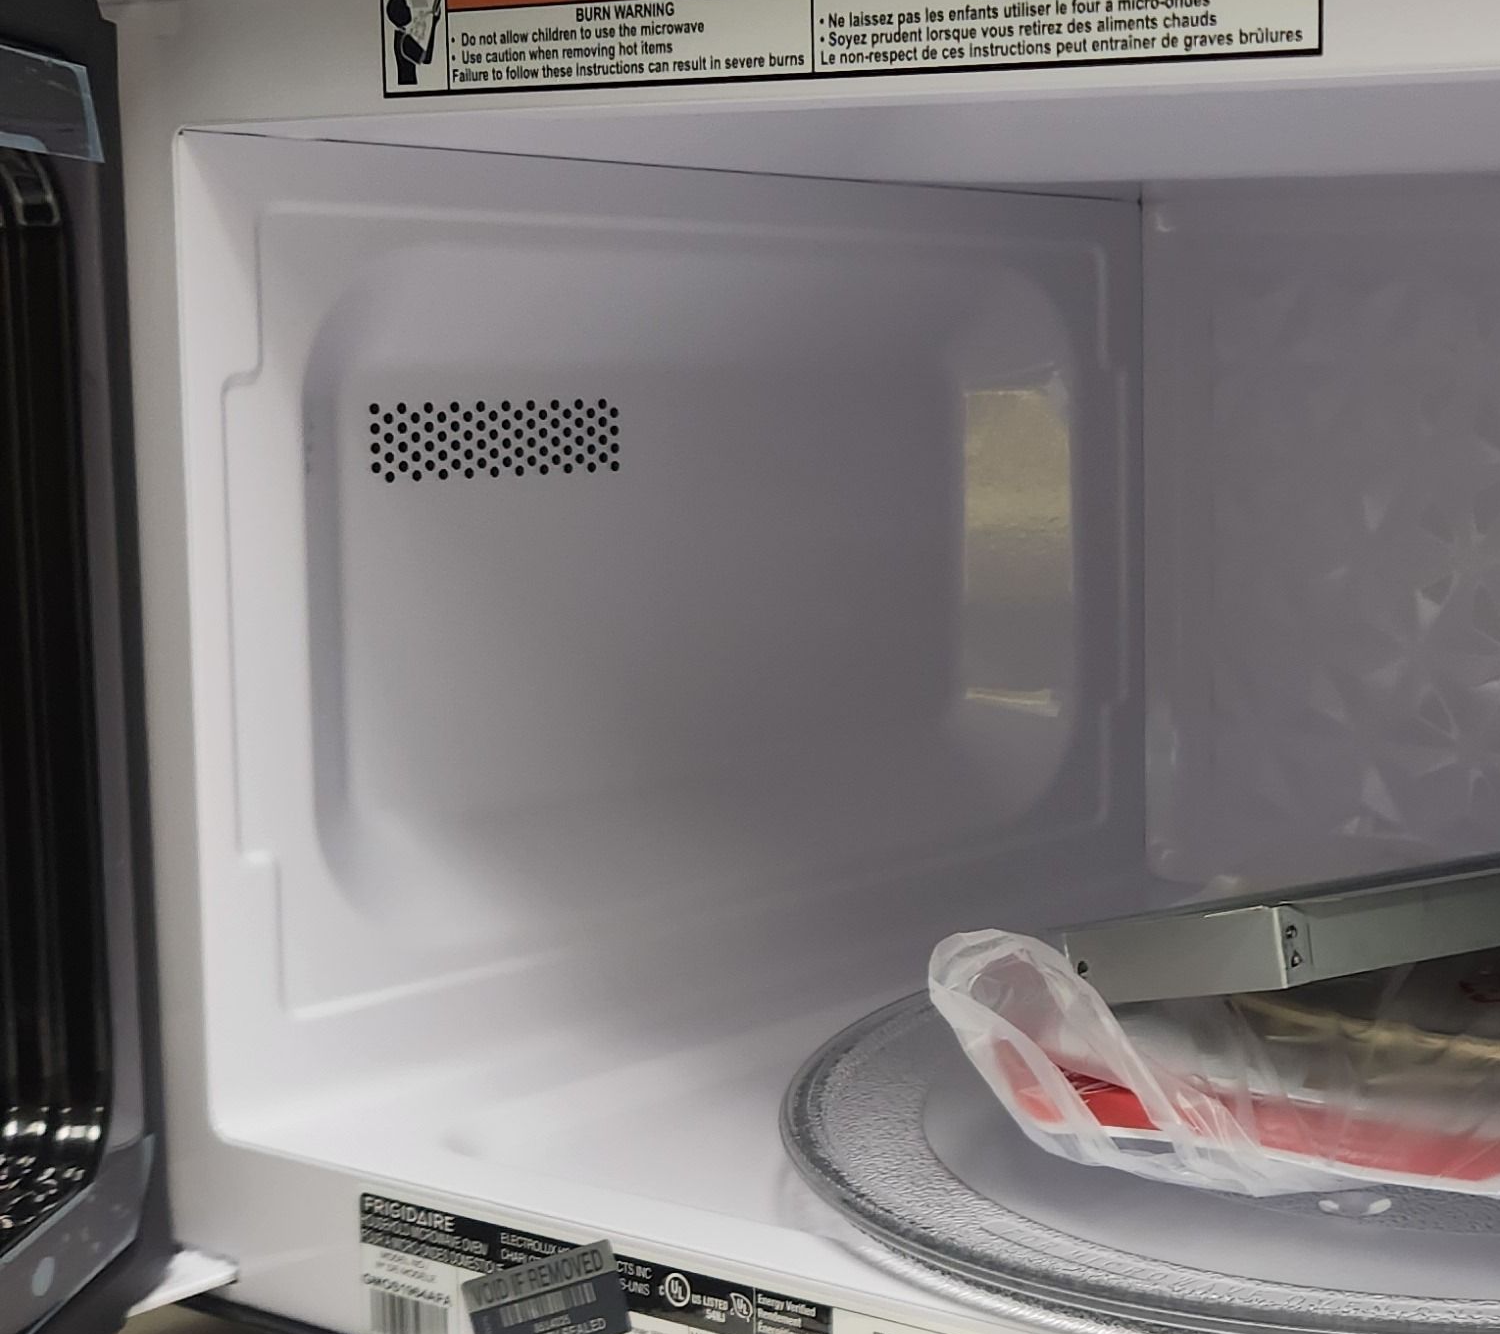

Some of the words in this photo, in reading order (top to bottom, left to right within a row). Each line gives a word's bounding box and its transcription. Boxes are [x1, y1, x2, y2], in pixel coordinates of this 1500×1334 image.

[576, 7, 611, 22] BURN
[614, 2, 674, 18] WARNING
[828, 13, 845, 28] Ne
[849, 11, 894, 27] laissez
[898, 11, 921, 30] pas
[925, 7, 944, 23] les
[949, 4, 999, 21] enfants
[1004, 1, 1051, 18] utiliser
[1056, 0, 1067, 14] le
[461, 33, 476, 46] Do
[479, 32, 497, 45] not
[500, 30, 528, 44] allow
[532, 27, 577, 42] children
[580, 27, 592, 40] to
[595, 27, 615, 38] use
[619, 23, 637, 37] the
[641, 21, 704, 36] microwave
[828, 31, 867, 50] Soyez
[871, 28, 922, 48] prudent
[927, 26, 976, 43] lorsque
[981, 24, 1014, 38] vous
[1019, 20, 1063, 36] retirez
[1067, 18, 1092, 34] des
[1097, 14, 1158, 32] aliments
[1163, 10, 1217, 29] chauds
[461, 50, 482, 64] Use
[486, 47, 526, 63] caution
[529, 46, 559, 60] when
[562, 43, 615, 60] removing
[619, 41, 638, 55] hot
[641, 40, 673, 55] items
[821, 51, 836, 65] Le
[840, 47, 917, 65] non-respect
[922, 45, 938, 60] de
[942, 47, 965, 59] ces
[1056, 38, 1088, 57] peut
[1161, 33, 1178, 49] de
[1184, 33, 1233, 51] graves
[1239, 27, 1303, 45] brûlures
[452, 68, 489, 83] Failure
[492, 67, 503, 81] to
[506, 65, 539, 80] follow
[542, 63, 573, 78] these
[649, 61, 671, 75] can
[673, 56, 707, 71] result
[710, 56, 721, 69] in
[725, 55, 765, 69] severe
[769, 53, 805, 67] burns
[365, 1196, 455, 1233] FRIGIDAIRE
[473, 1277, 509, 1307] VOID
[511, 1271, 524, 1293] IF
[528, 1248, 604, 1289] REMOVED
